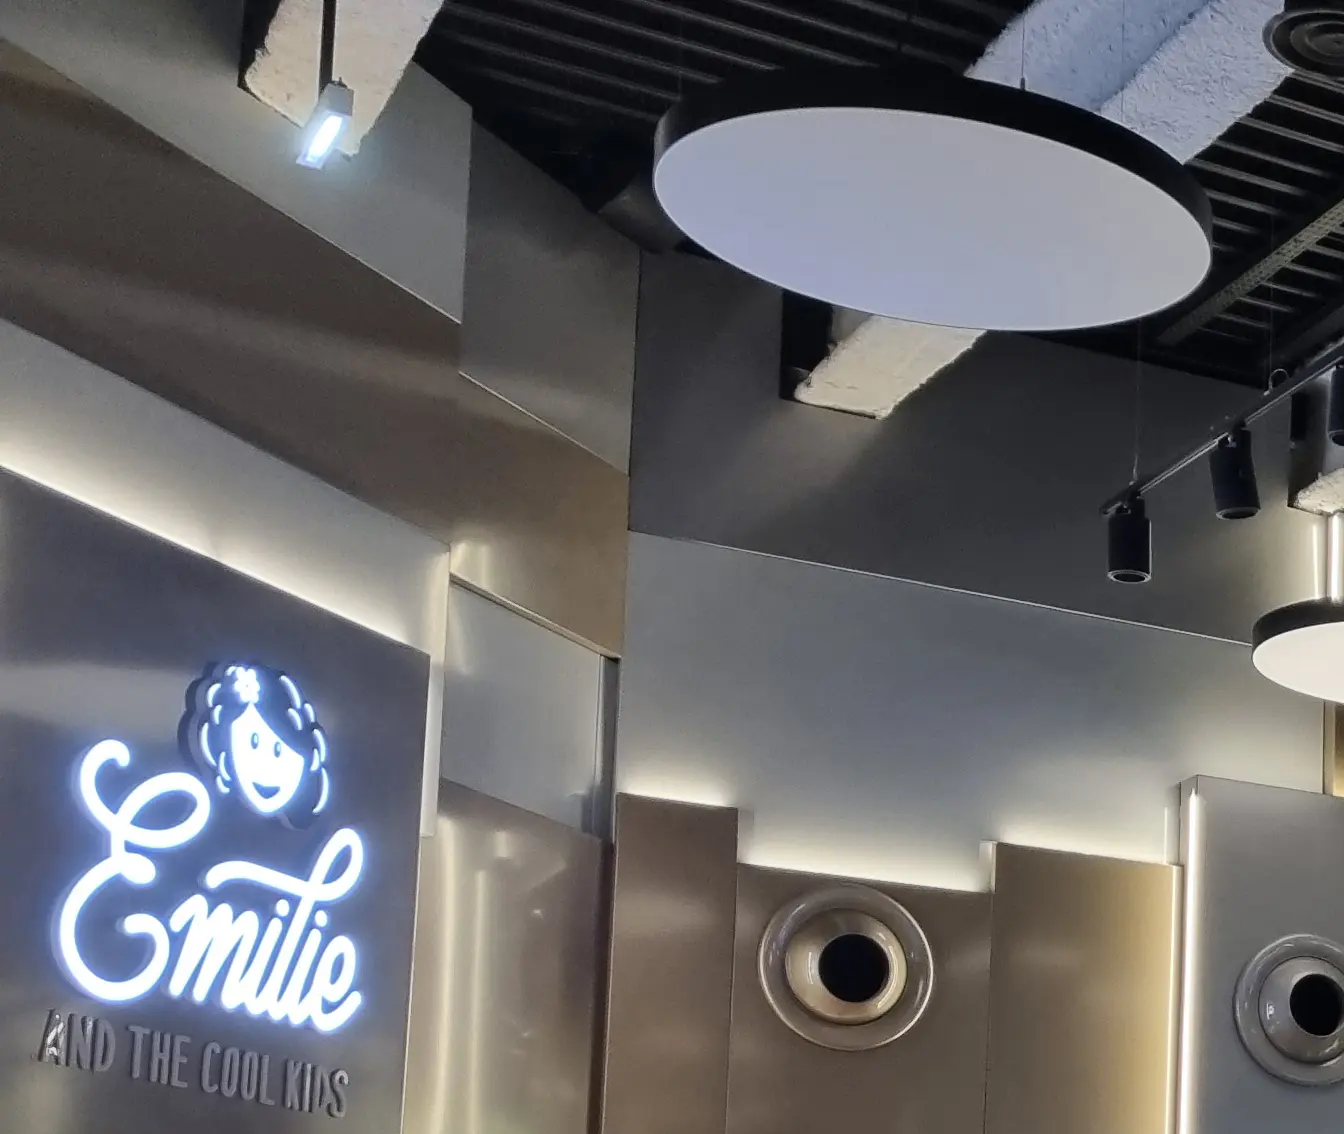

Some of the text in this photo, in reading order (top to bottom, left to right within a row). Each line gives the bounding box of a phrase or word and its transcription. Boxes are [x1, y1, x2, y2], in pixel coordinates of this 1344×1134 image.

[59, 738, 363, 1033] Emilie
[39, 1009, 349, 1119] AND THE COOL KIDS
